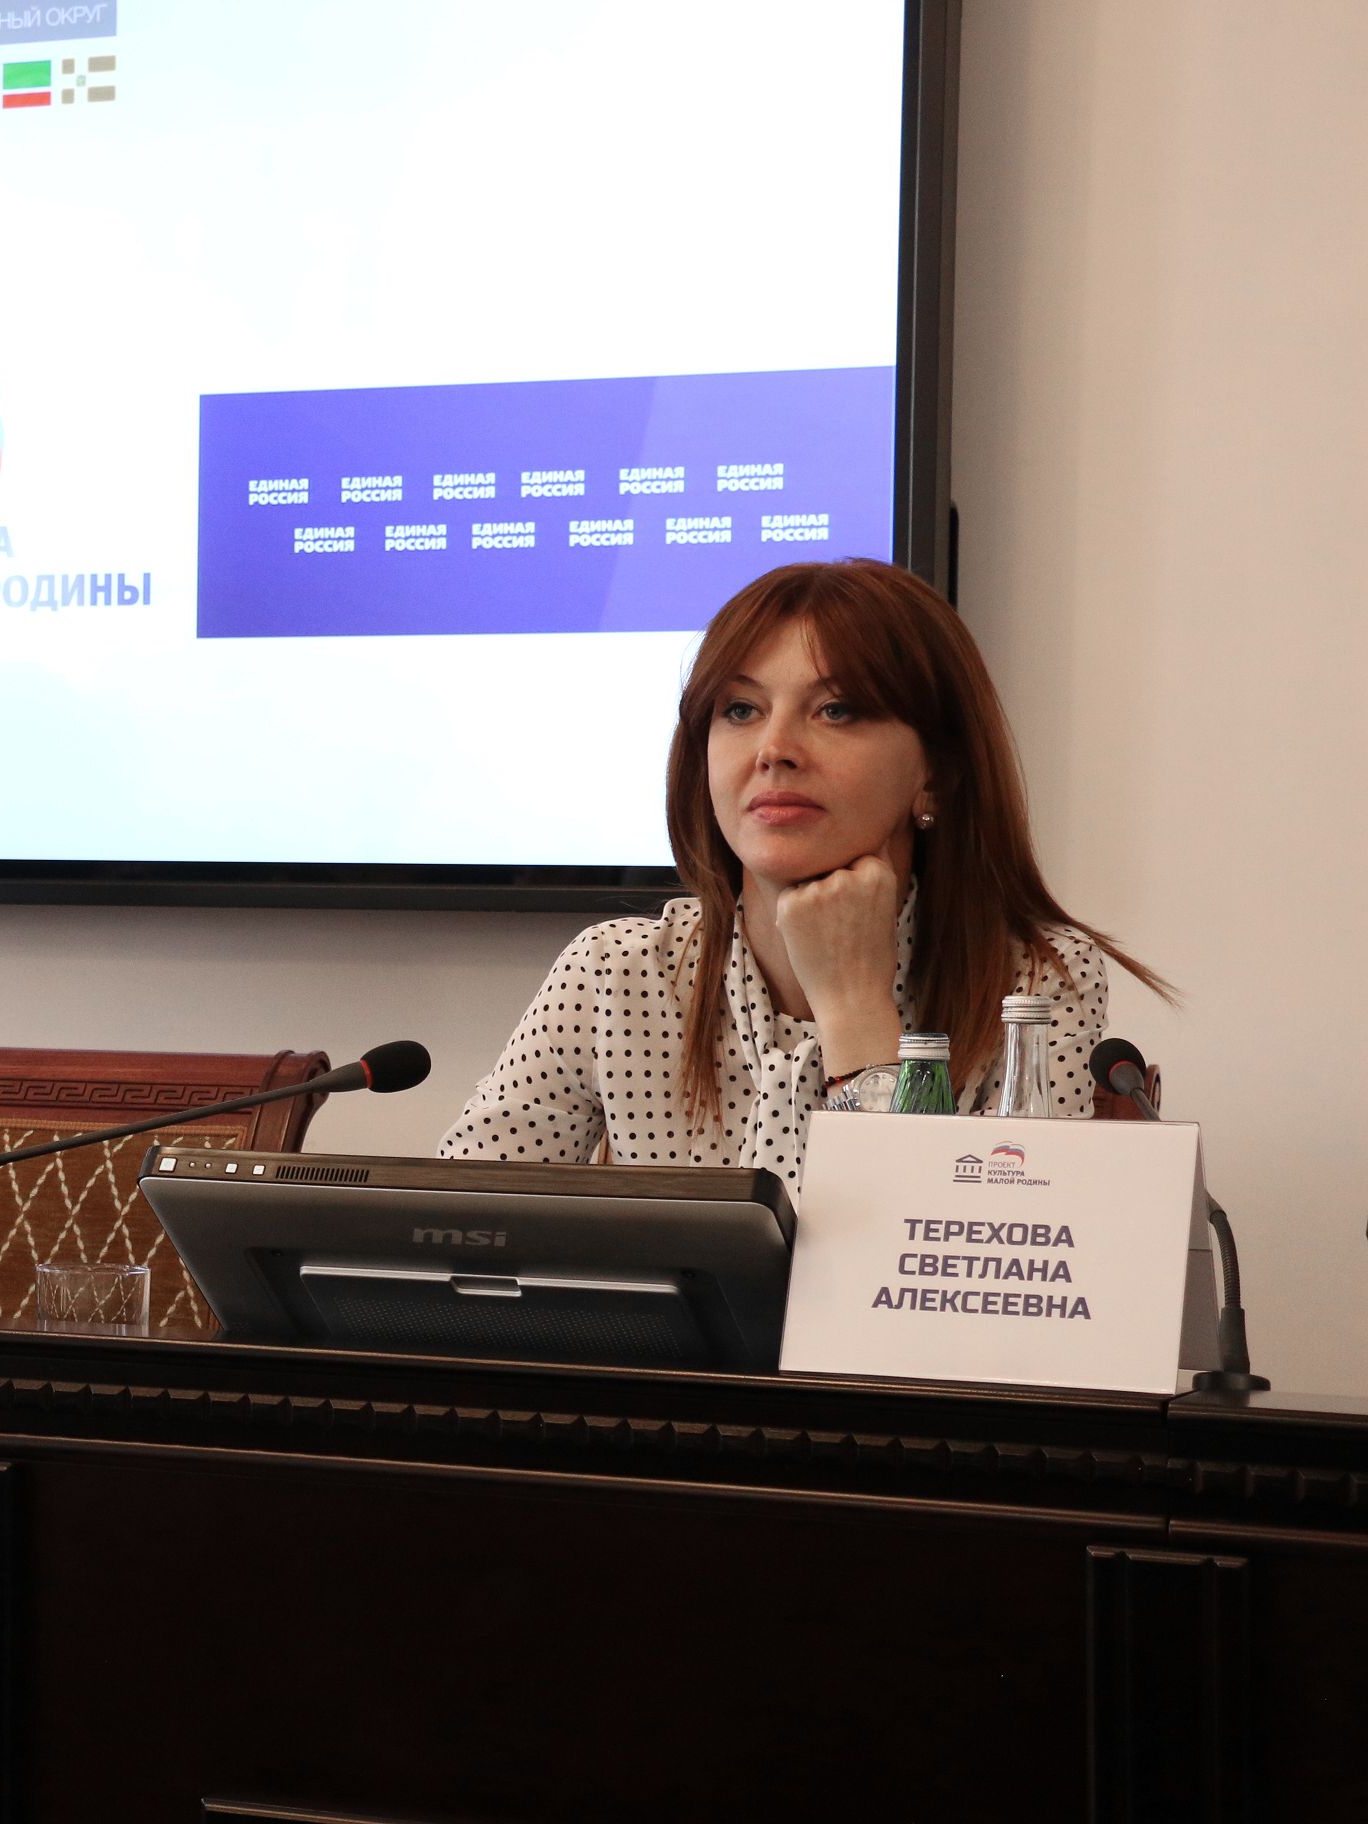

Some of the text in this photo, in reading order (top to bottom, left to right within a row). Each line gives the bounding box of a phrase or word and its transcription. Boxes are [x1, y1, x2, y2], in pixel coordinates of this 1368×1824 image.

[46, 4, 107, 27] ОКРУГ
[521, 470, 584, 484] ЕДИНАЯ
[619, 466, 684, 482] ЕДИНАЯ
[717, 463, 784, 478] ЕДИНАЯ
[248, 478, 308, 492] ЕДИНАЯ
[341, 476, 402, 490] ЕДИНАЯ
[433, 472, 496, 487] ЕДИНАЯ
[717, 477, 784, 492] РОССИЯ
[433, 486, 496, 500] РОССИЯ
[521, 483, 584, 497] РОССИЯ
[619, 480, 684, 495] РОССИЯ
[248, 491, 308, 506] РОССИЯ
[341, 489, 402, 503] РОССИЯ
[472, 522, 535, 536] ЕДИНАЯ
[569, 519, 634, 534] ЕДИНАЯ
[666, 517, 732, 532] ЕДИНАЯ
[761, 514, 829, 529] ЕДИНАЯ
[294, 526, 354, 540] ЕДИНАЯ
[385, 524, 447, 538] ЕДИНАЯ
[666, 530, 732, 544] РОССИЯ
[761, 527, 829, 542] РОССИЯ
[294, 539, 354, 554] РОССИЯ
[385, 537, 447, 552] РОССИЯ
[472, 534, 535, 550] РОССИЯ
[569, 532, 634, 547] РОССИЯ
[1016, 1178, 1050, 1186] РОДИНЫ
[412, 1228, 506, 1247] msi
[904, 1218, 1075, 1248] ТЕРЕХОВА
[898, 1253, 1072, 1283] СВЕТЛАНА
[872, 1286, 1092, 1320] АЛЕКСЕЕВНА
